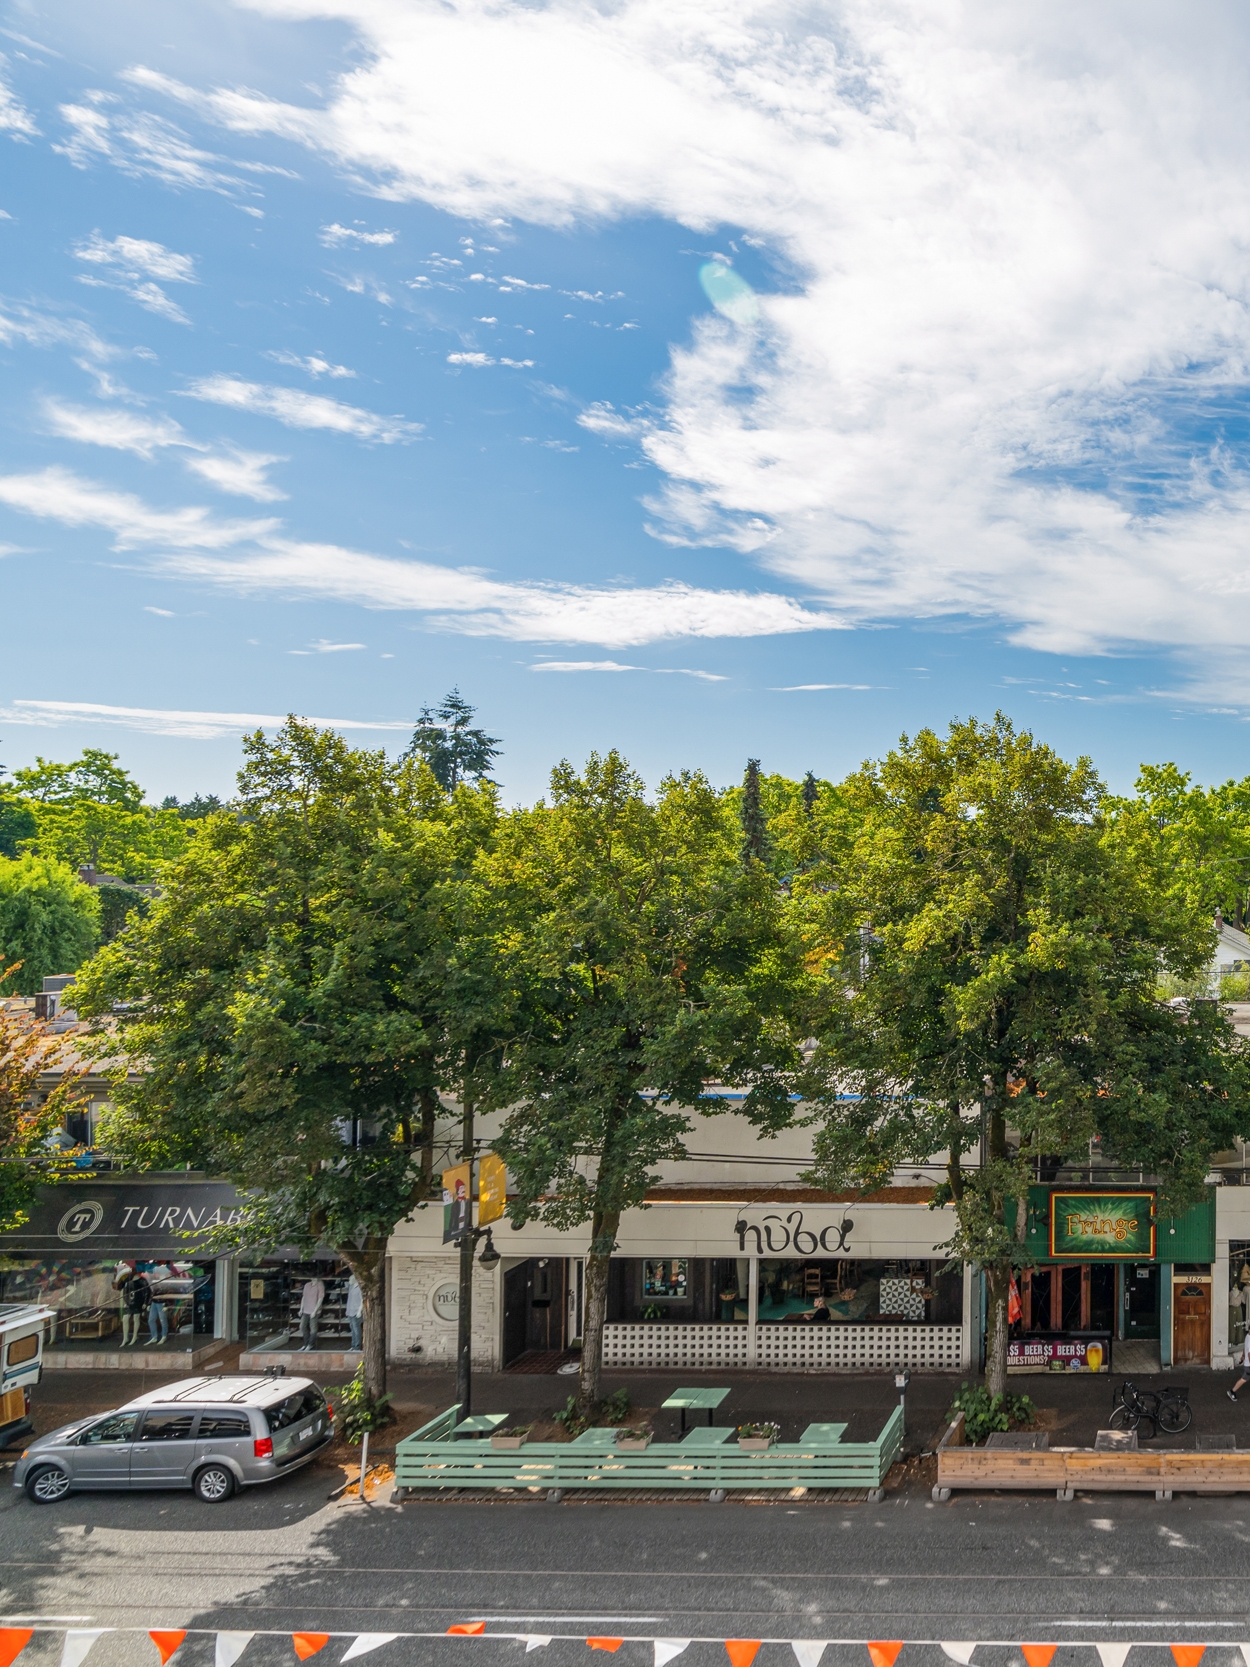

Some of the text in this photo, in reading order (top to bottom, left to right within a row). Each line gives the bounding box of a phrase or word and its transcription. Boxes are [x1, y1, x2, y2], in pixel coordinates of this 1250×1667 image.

[120, 1206, 257, 1230] TURNAB
[1065, 1214, 1139, 1241] Fringe
[1010, 1344, 1086, 1357] $5 BEER $5 BEER $5
[1007, 1355, 1048, 1365] QUESTIONS?
